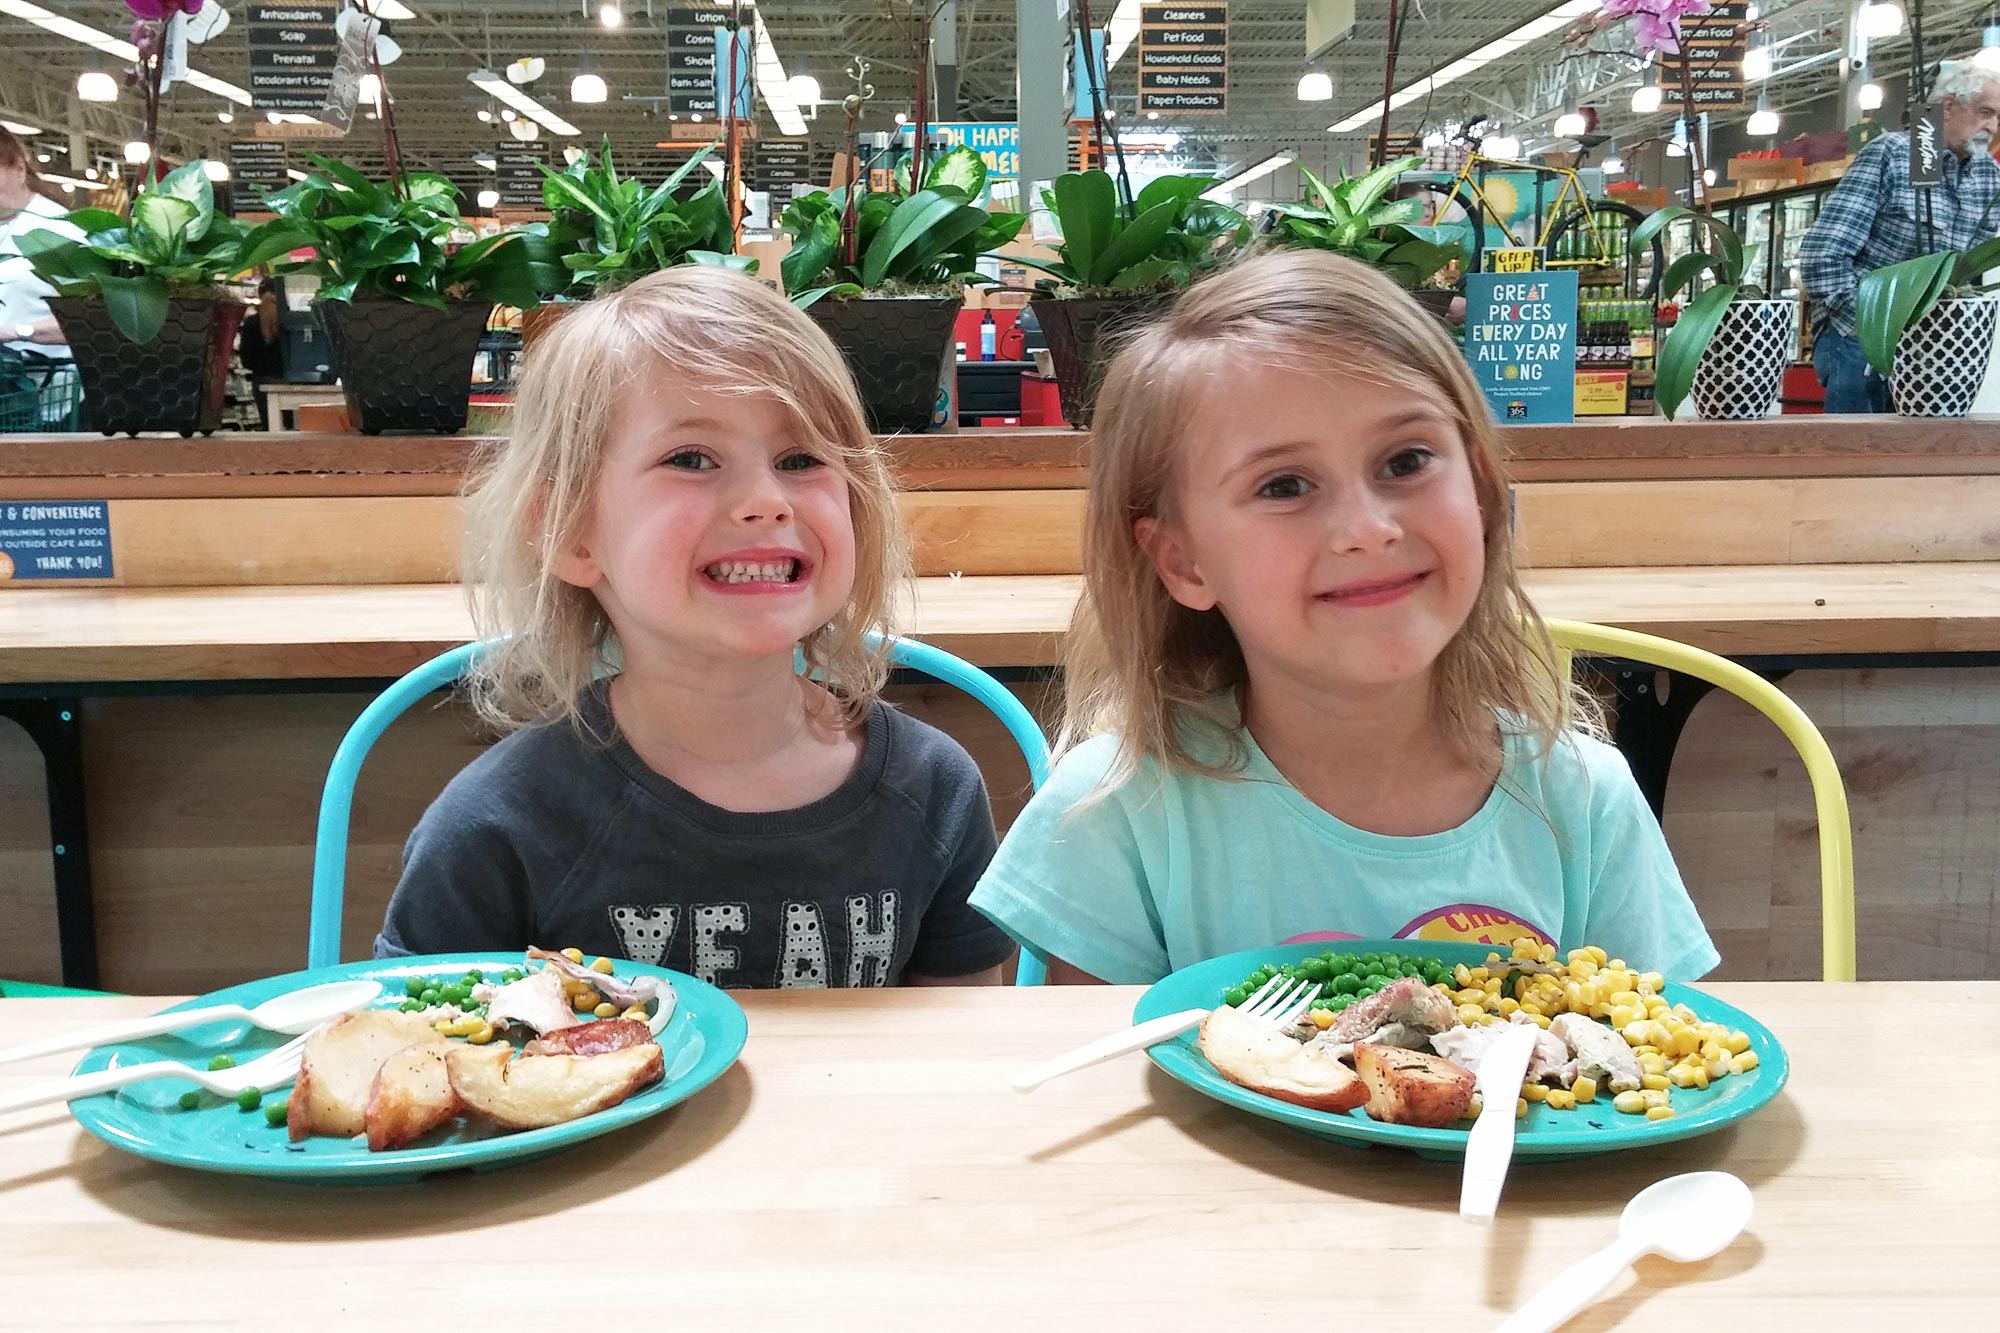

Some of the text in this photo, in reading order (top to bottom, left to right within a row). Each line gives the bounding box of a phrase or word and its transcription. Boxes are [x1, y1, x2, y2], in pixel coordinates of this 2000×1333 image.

[1163, 10, 1206, 20] Cleaners
[279, 30, 306, 43] Soap
[1163, 32, 1204, 43] Pet Food
[1710, 27, 1734, 37] Food
[272, 53, 316, 64] Prenatal
[1144, 53, 1222, 64] Household Goods
[1689, 48, 1719, 58] Candy
[1708, 68, 1731, 78] Bars
[254, 75, 301, 85] Deodorant
[671, 78, 692, 87] Bath
[1156, 74, 1211, 85] Baby Needs
[1714, 90, 1735, 99] Bulk
[1147, 95, 1219, 106] Paper Products
[1493, 283, 1549, 301] GREAT
[1489, 303, 1552, 321] PRICES
[1473, 320, 1568, 341] EVERY DAY
[1478, 343, 1561, 361] ALL YEAR
[1494, 363, 1543, 381] LONG
[1509, 406, 1525, 416] 365
[7, 506, 17, 521] &
[22, 506, 102, 521] CONVENIENCE
[48, 528, 77, 537] YOUR
[78, 527, 107, 536] FOOD
[5, 540, 48, 549] OUTSIDE
[77, 539, 104, 548] AREA
[36, 555, 103, 570] THANK YOU!
